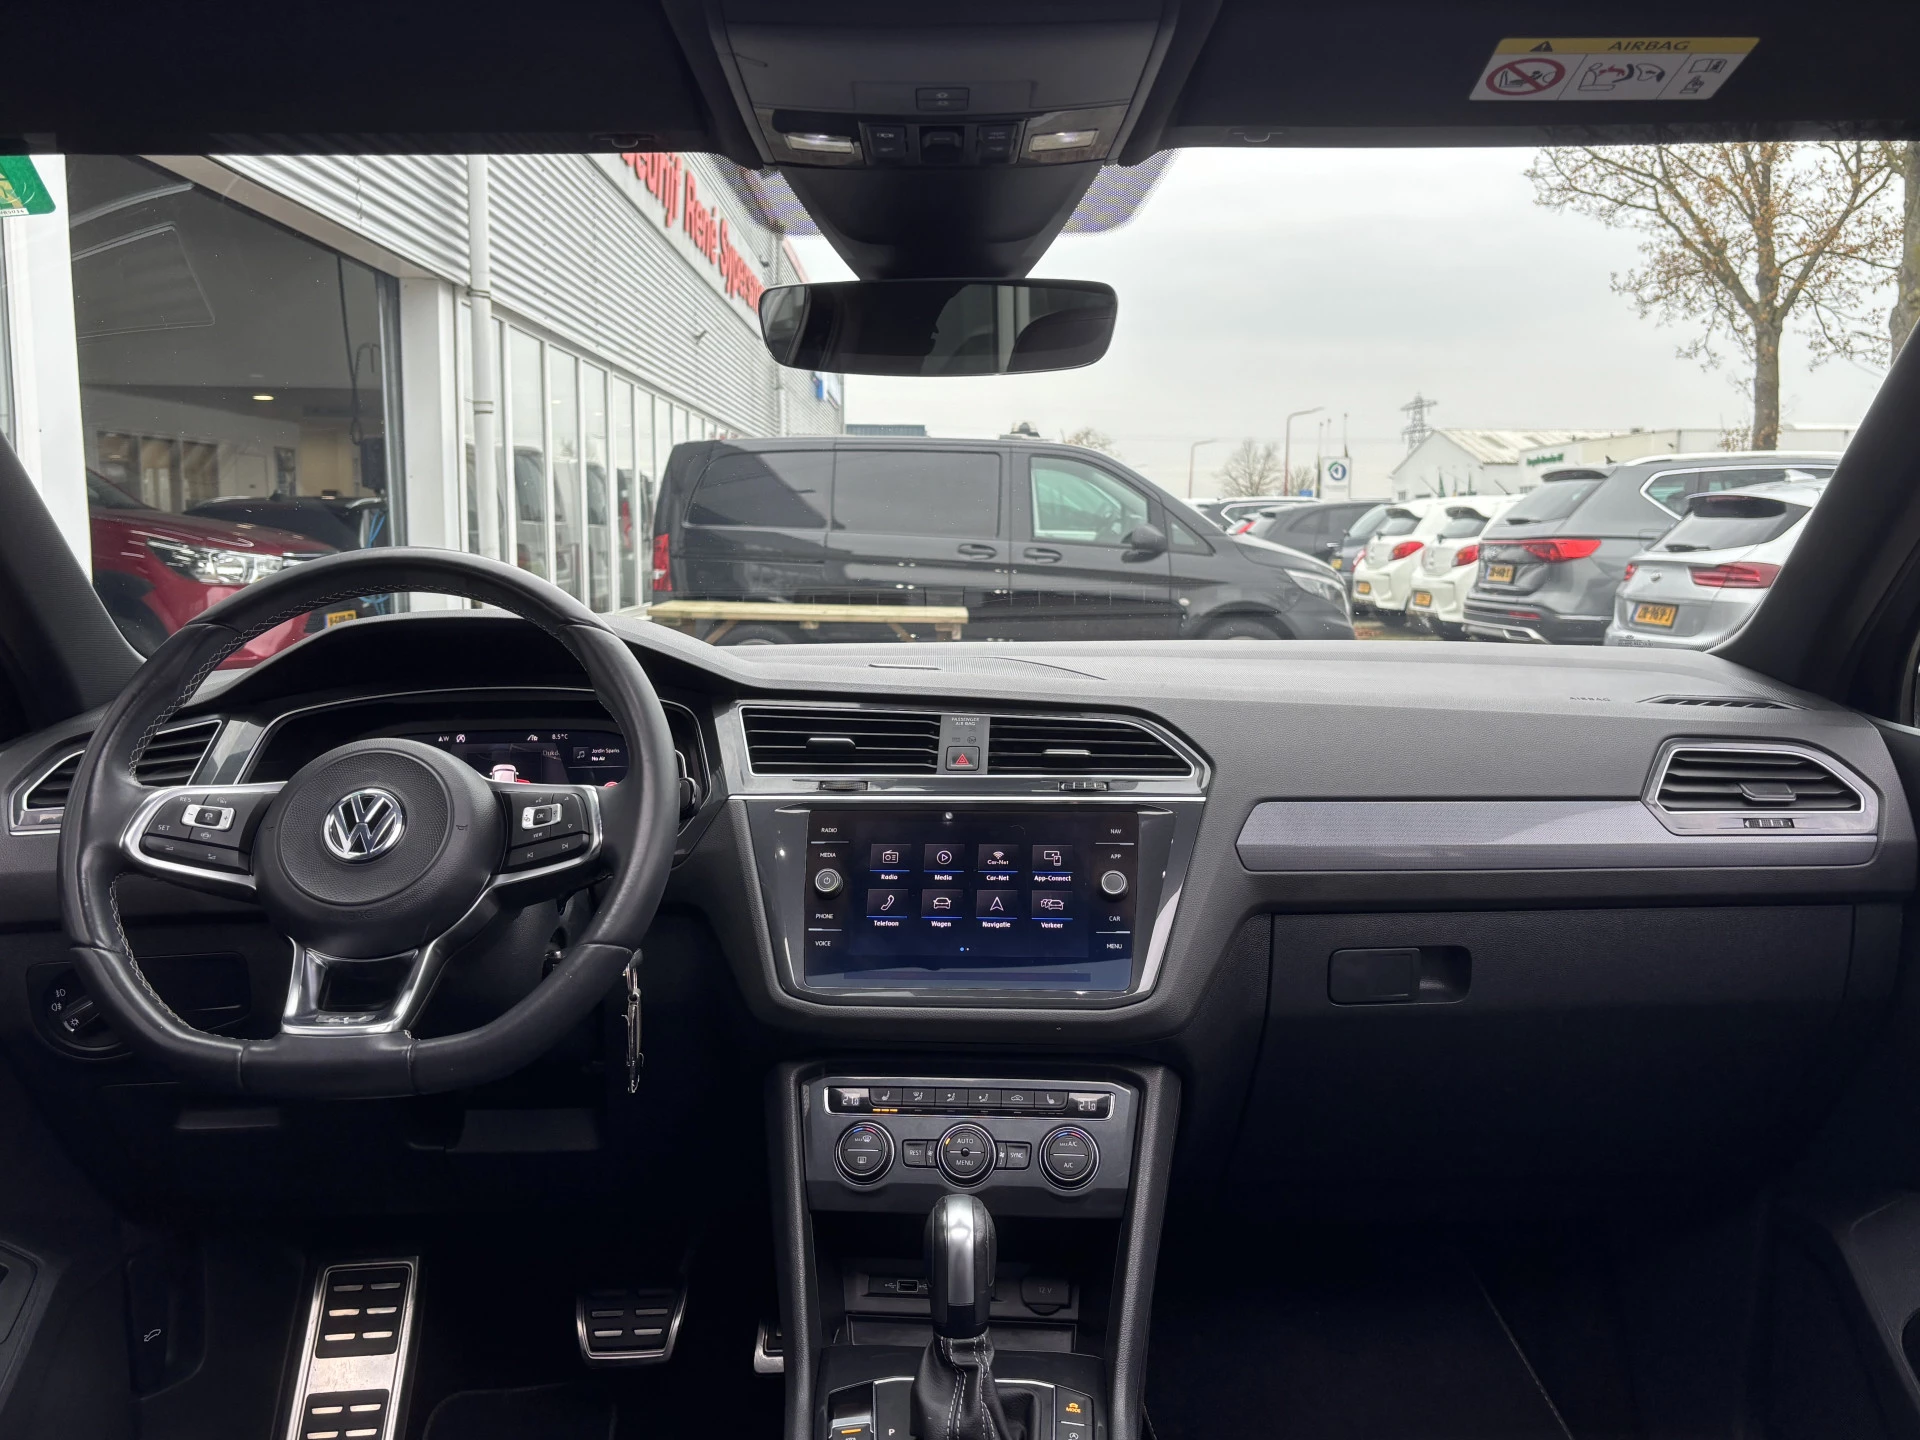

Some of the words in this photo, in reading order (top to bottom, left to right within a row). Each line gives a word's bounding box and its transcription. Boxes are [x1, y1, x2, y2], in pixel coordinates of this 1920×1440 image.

[1607, 41, 1690, 51] AIRBAG
[684, 169, 719, 265] René
[1033, 875, 1072, 883] App-Connect
[982, 921, 1011, 929] Navigatie
[888, 1428, 896, 1436] P
